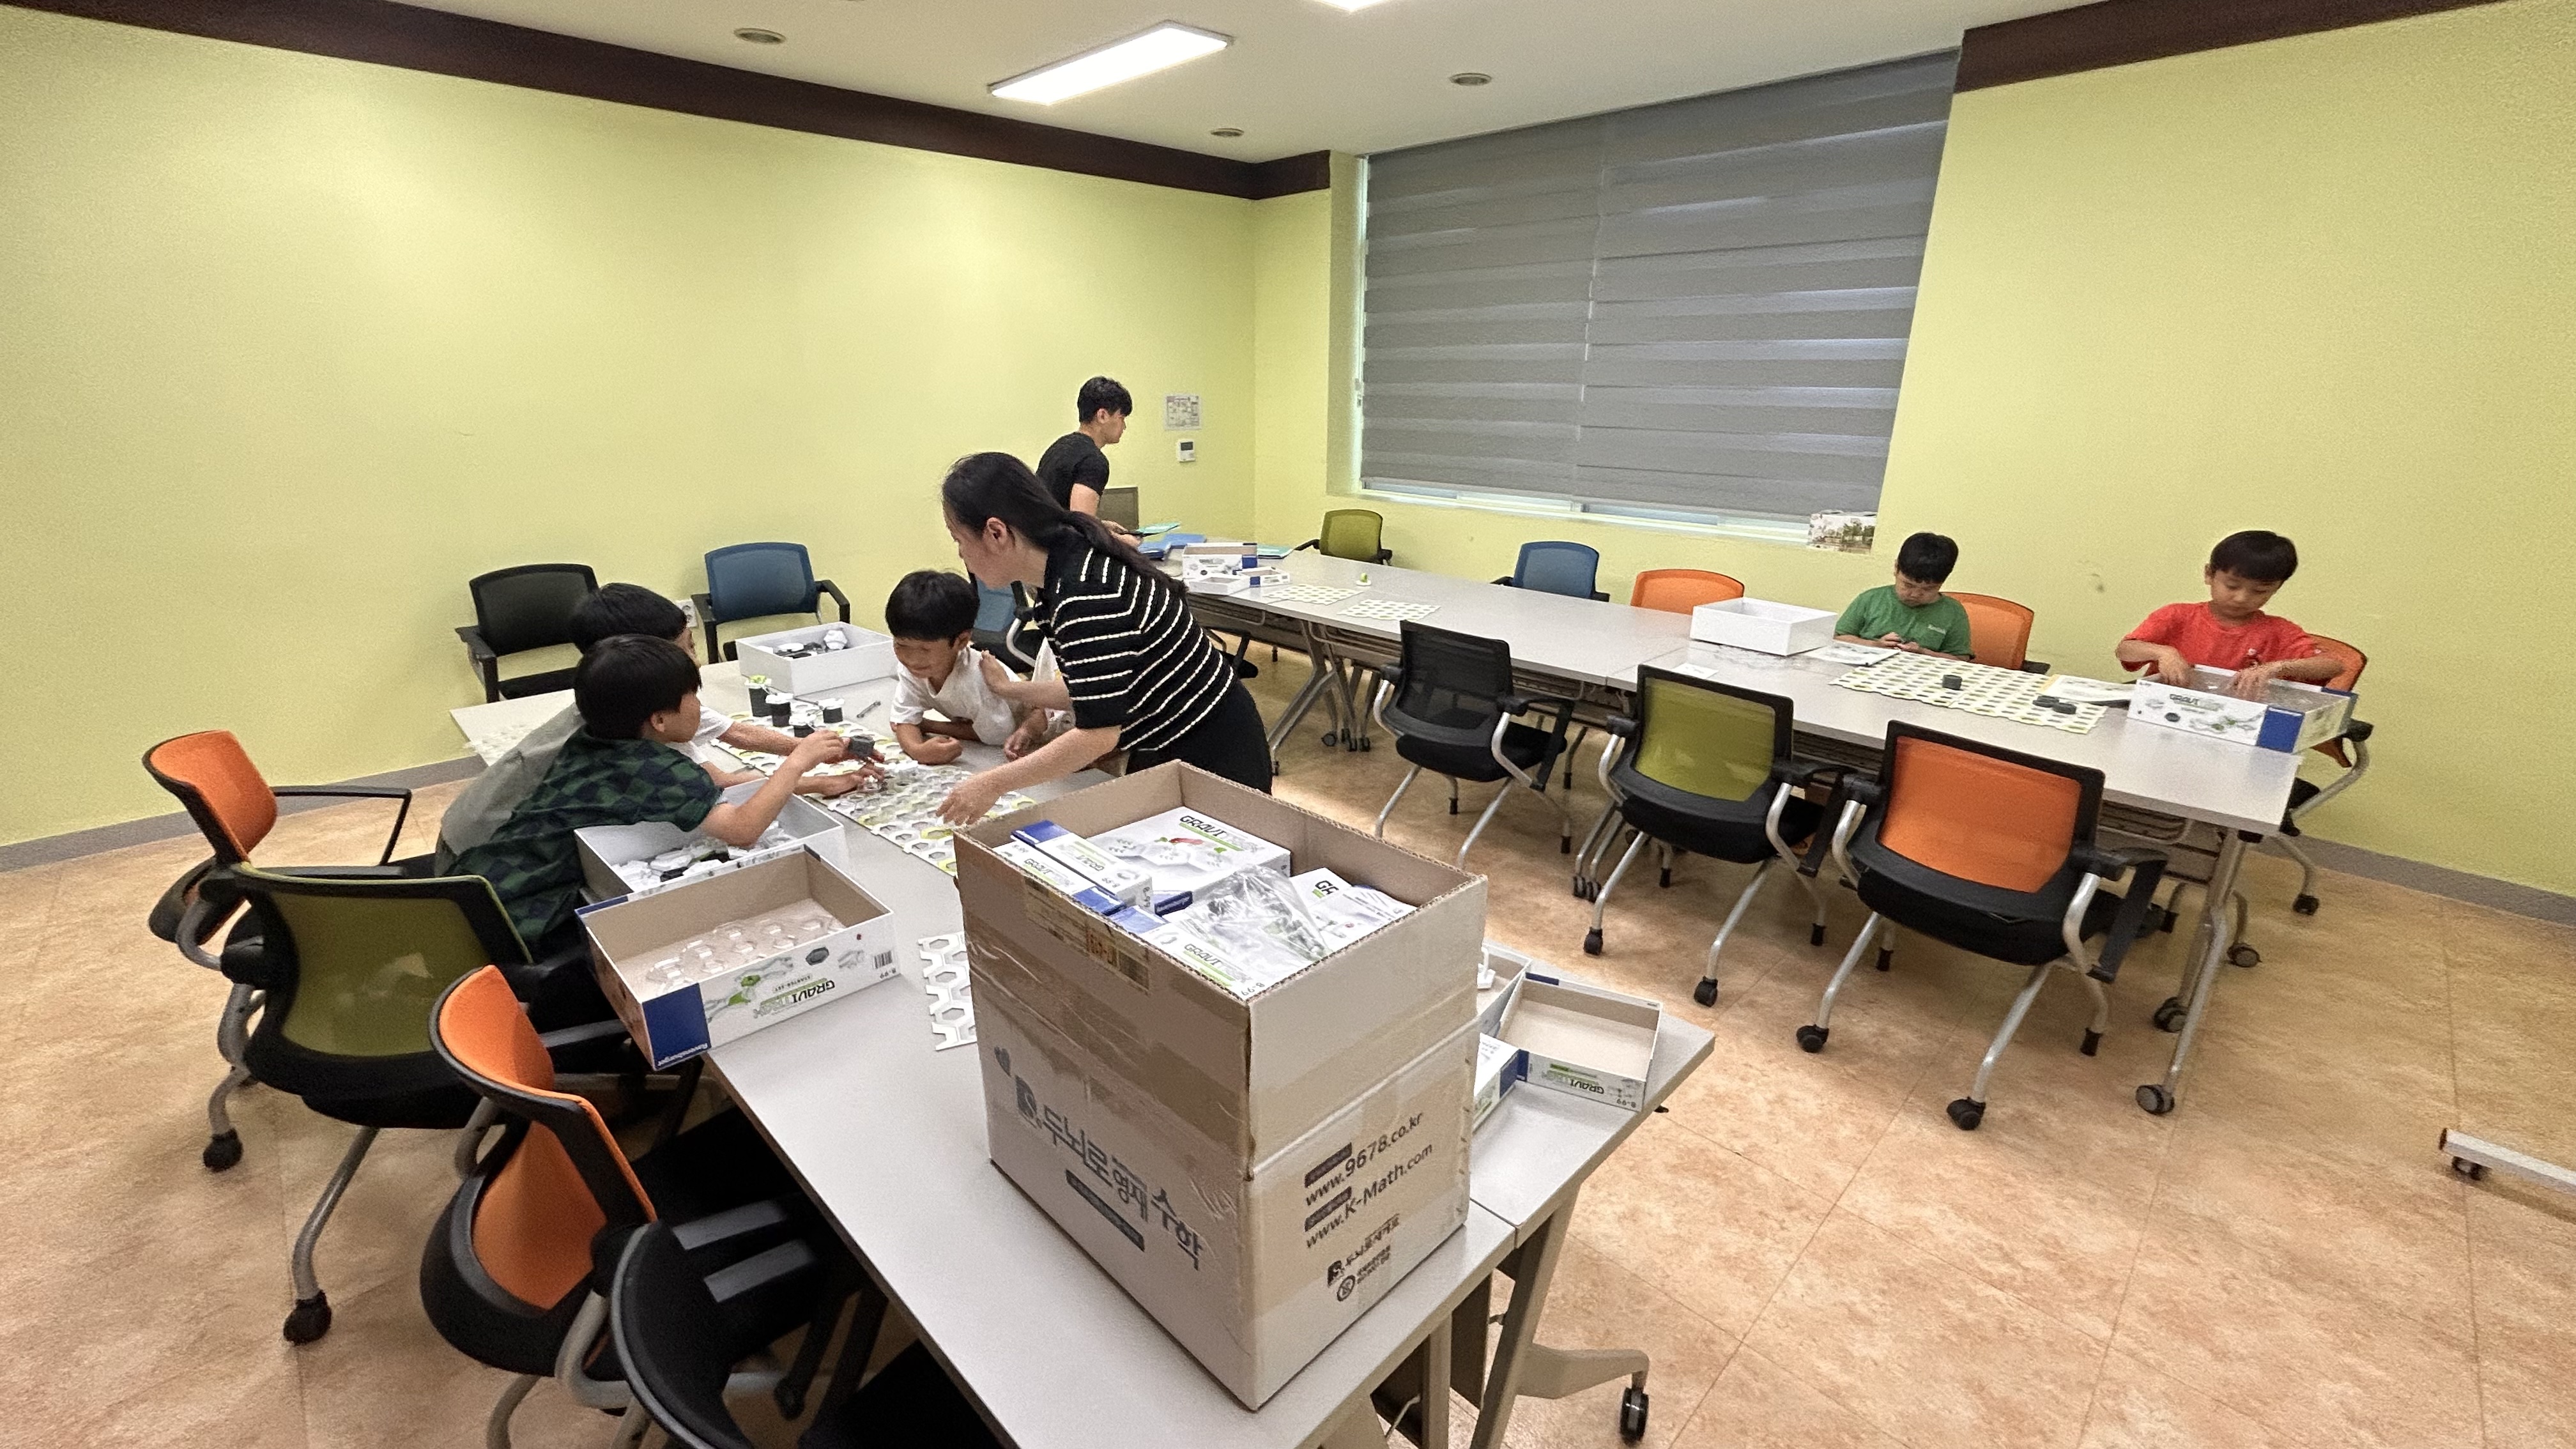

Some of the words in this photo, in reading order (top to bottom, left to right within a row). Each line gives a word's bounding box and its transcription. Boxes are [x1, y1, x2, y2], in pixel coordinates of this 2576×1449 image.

[1241, 982, 1266, 997] 8-99
[1616, 1098, 1637, 1108] 8-99
[1306, 1112, 1423, 1206] www.9678.co.kr
[1306, 1144, 1432, 1248] www.K-Math.com
